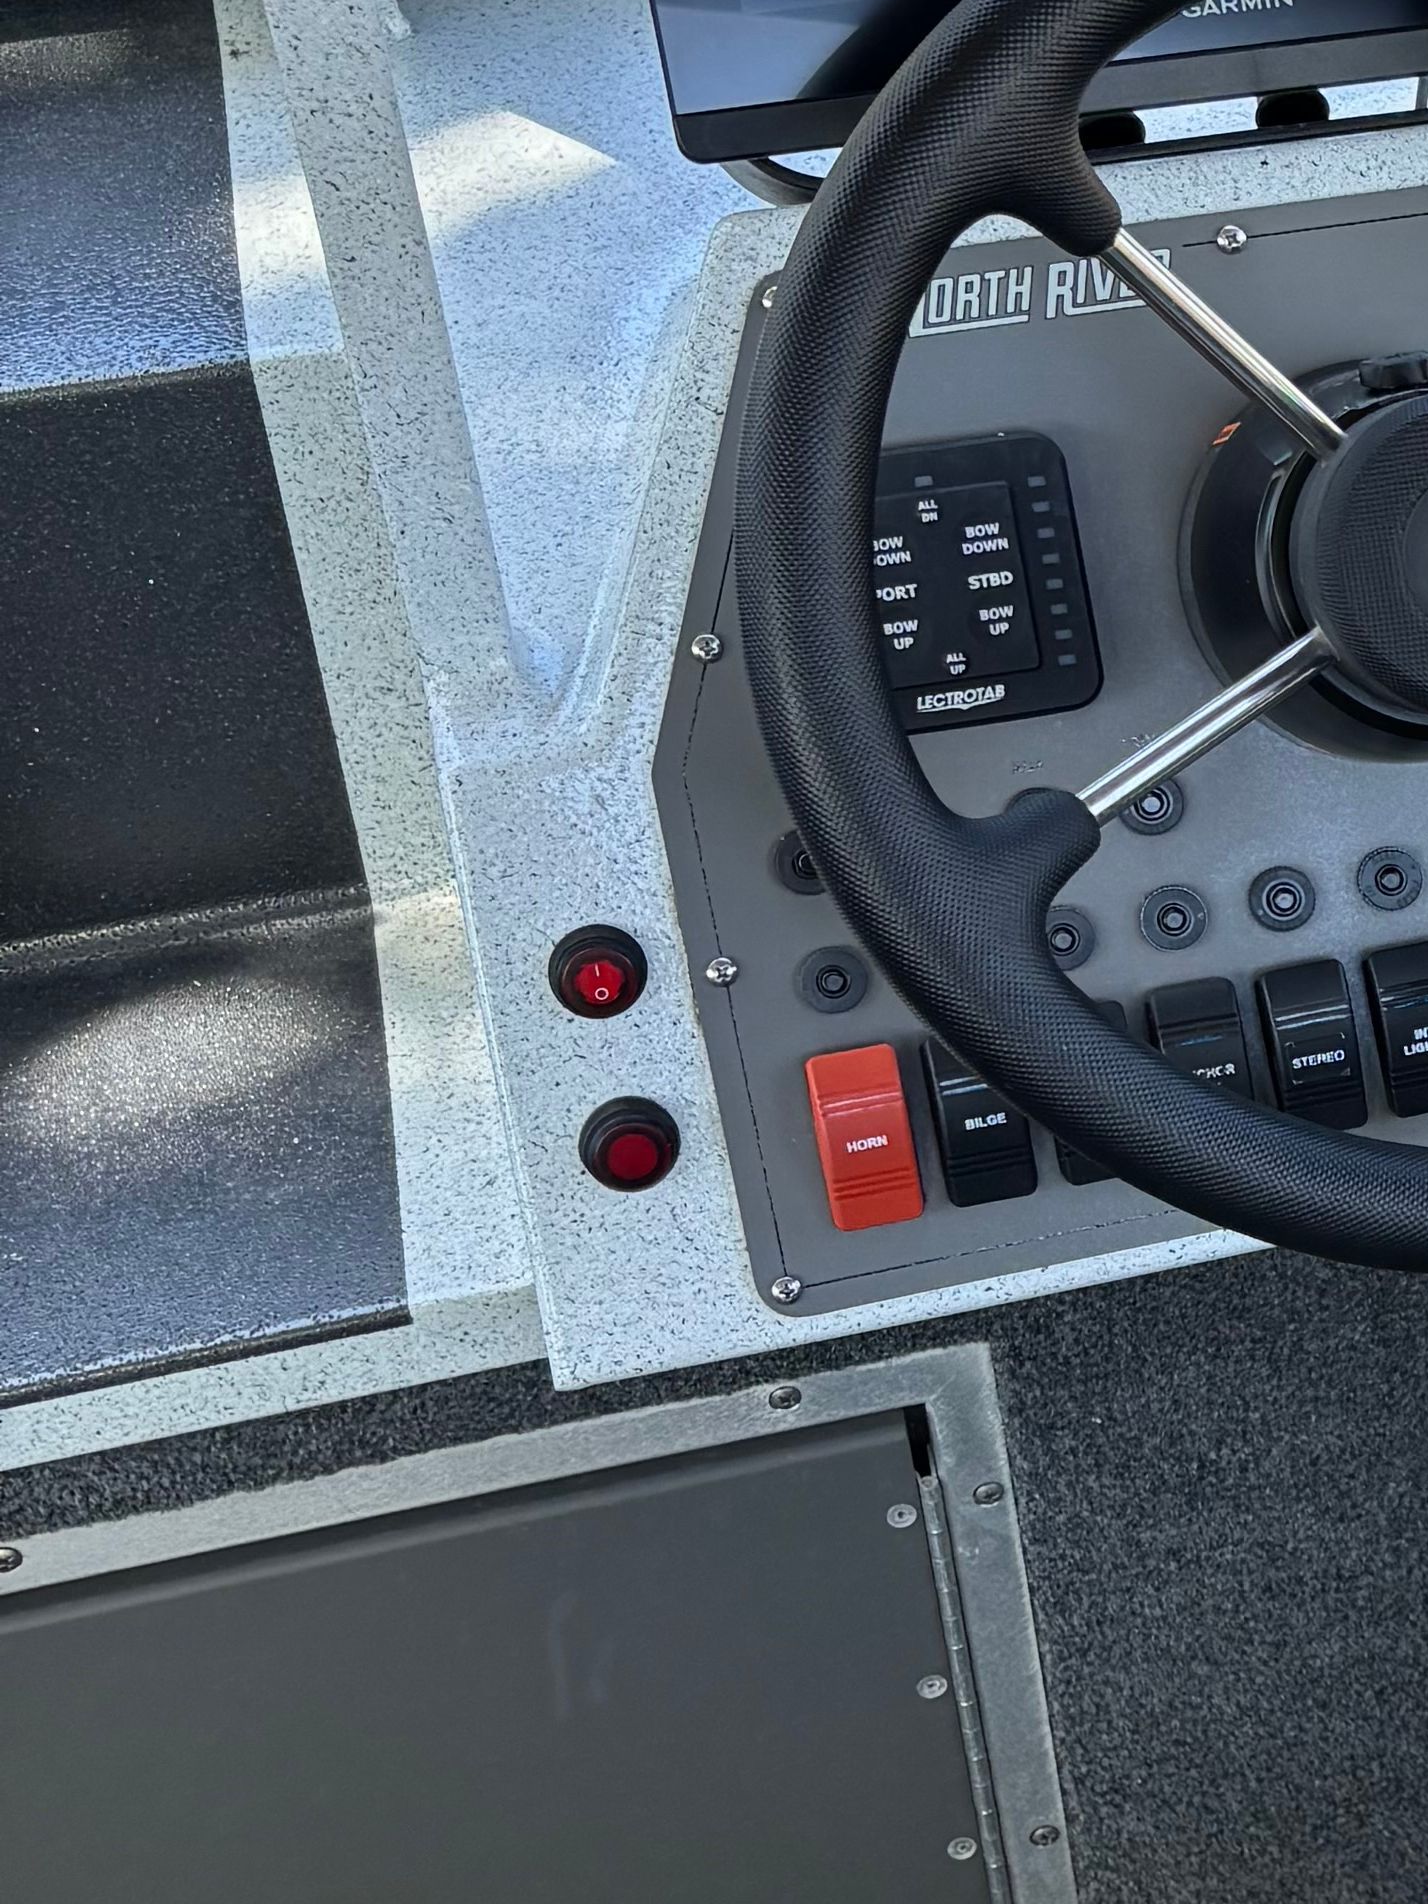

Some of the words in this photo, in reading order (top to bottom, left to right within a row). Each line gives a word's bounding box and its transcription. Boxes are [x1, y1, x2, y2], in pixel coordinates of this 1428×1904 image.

[918, 499, 938, 511] ALL
[921, 512, 938, 523] DN
[965, 522, 1000, 539] BOW
[962, 537, 1009, 555] DOWN
[873, 550, 912, 567] OWN
[967, 571, 1014, 590] STBD
[978, 605, 1014, 622] BOW
[883, 619, 919, 636] BOW
[989, 622, 1010, 636] UP
[893, 637, 914, 650] UP
[946, 652, 966, 664] ALL
[949, 664, 966, 675] UP
[917, 684, 1006, 712] LECTROTAB
[1292, 1049, 1345, 1070] STEREO
[964, 1112, 1007, 1131] BILGE
[846, 1134, 889, 1153] HORN
